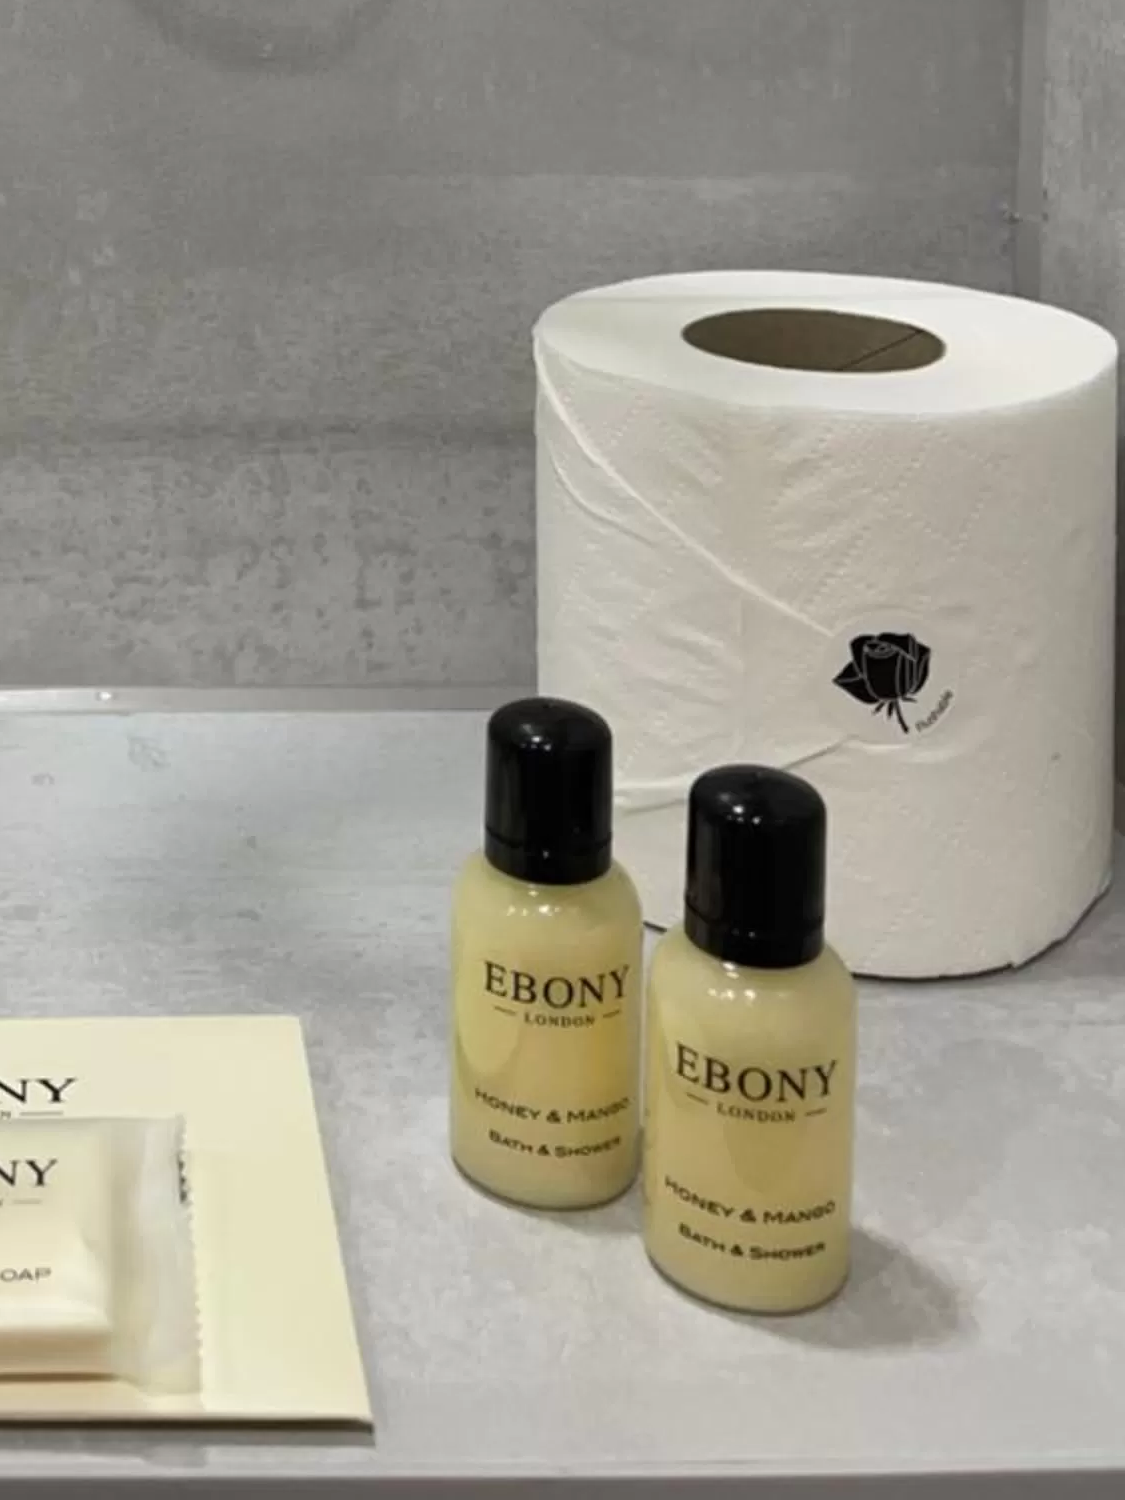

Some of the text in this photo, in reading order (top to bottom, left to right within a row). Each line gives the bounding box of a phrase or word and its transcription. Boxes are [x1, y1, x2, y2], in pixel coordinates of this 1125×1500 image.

[483, 960, 630, 1009] EBONY
[525, 1011, 596, 1028] LONDON
[676, 1040, 837, 1102] EBONY
[475, 1087, 632, 1125] HONEY & MANGO
[715, 1101, 796, 1123] LONDON
[489, 1128, 622, 1159] BATH & SHOWER
[664, 1174, 836, 1225] HONEY & MANGO
[679, 1222, 826, 1261] BATH & SHOWER
